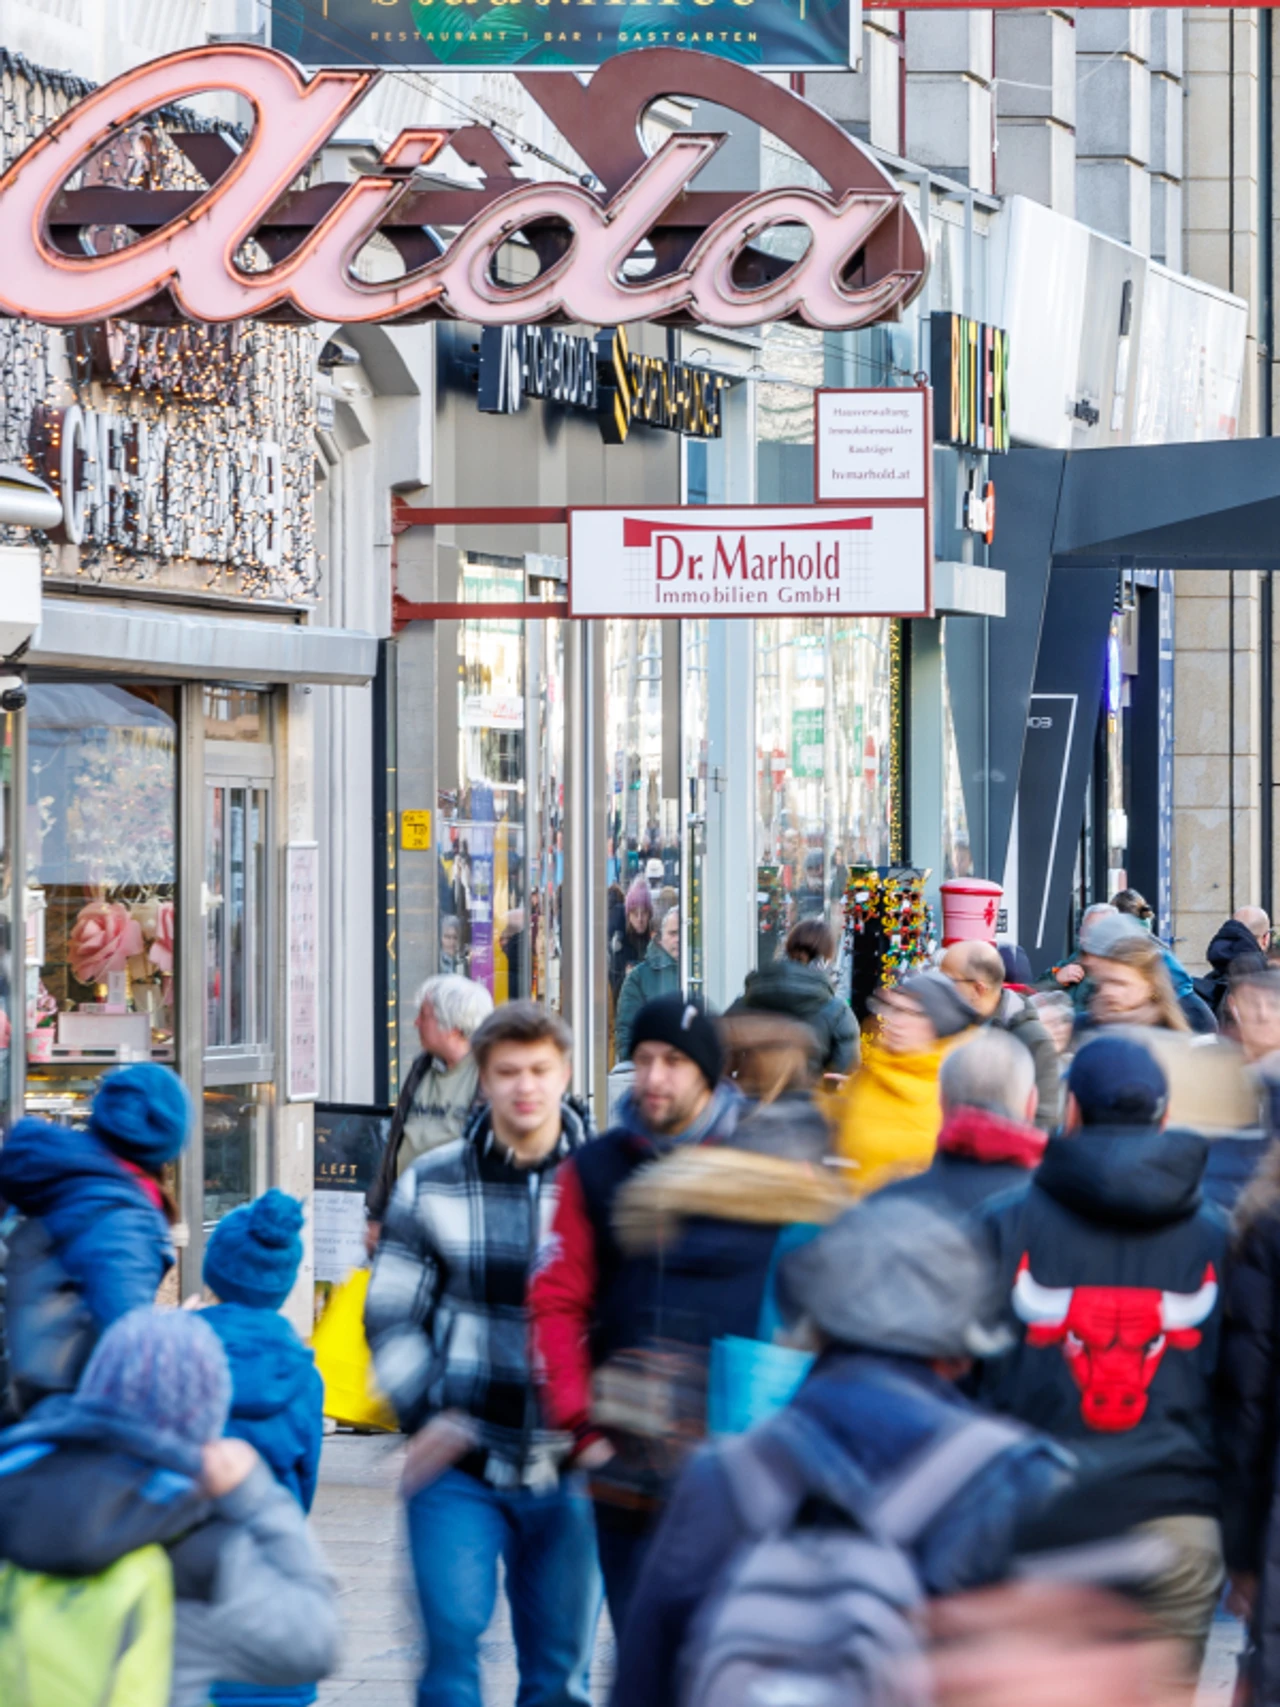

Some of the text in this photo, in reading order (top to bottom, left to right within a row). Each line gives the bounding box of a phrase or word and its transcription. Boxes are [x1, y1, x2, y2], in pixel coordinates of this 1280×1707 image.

[371, 31, 758, 43] RESTAURANT BAR GASTGARTEN
[656, 535, 841, 581] Dr. Marhold
[655, 582, 841, 604] Immobilien GmbH
[320, 1162, 358, 1177] LEFT
